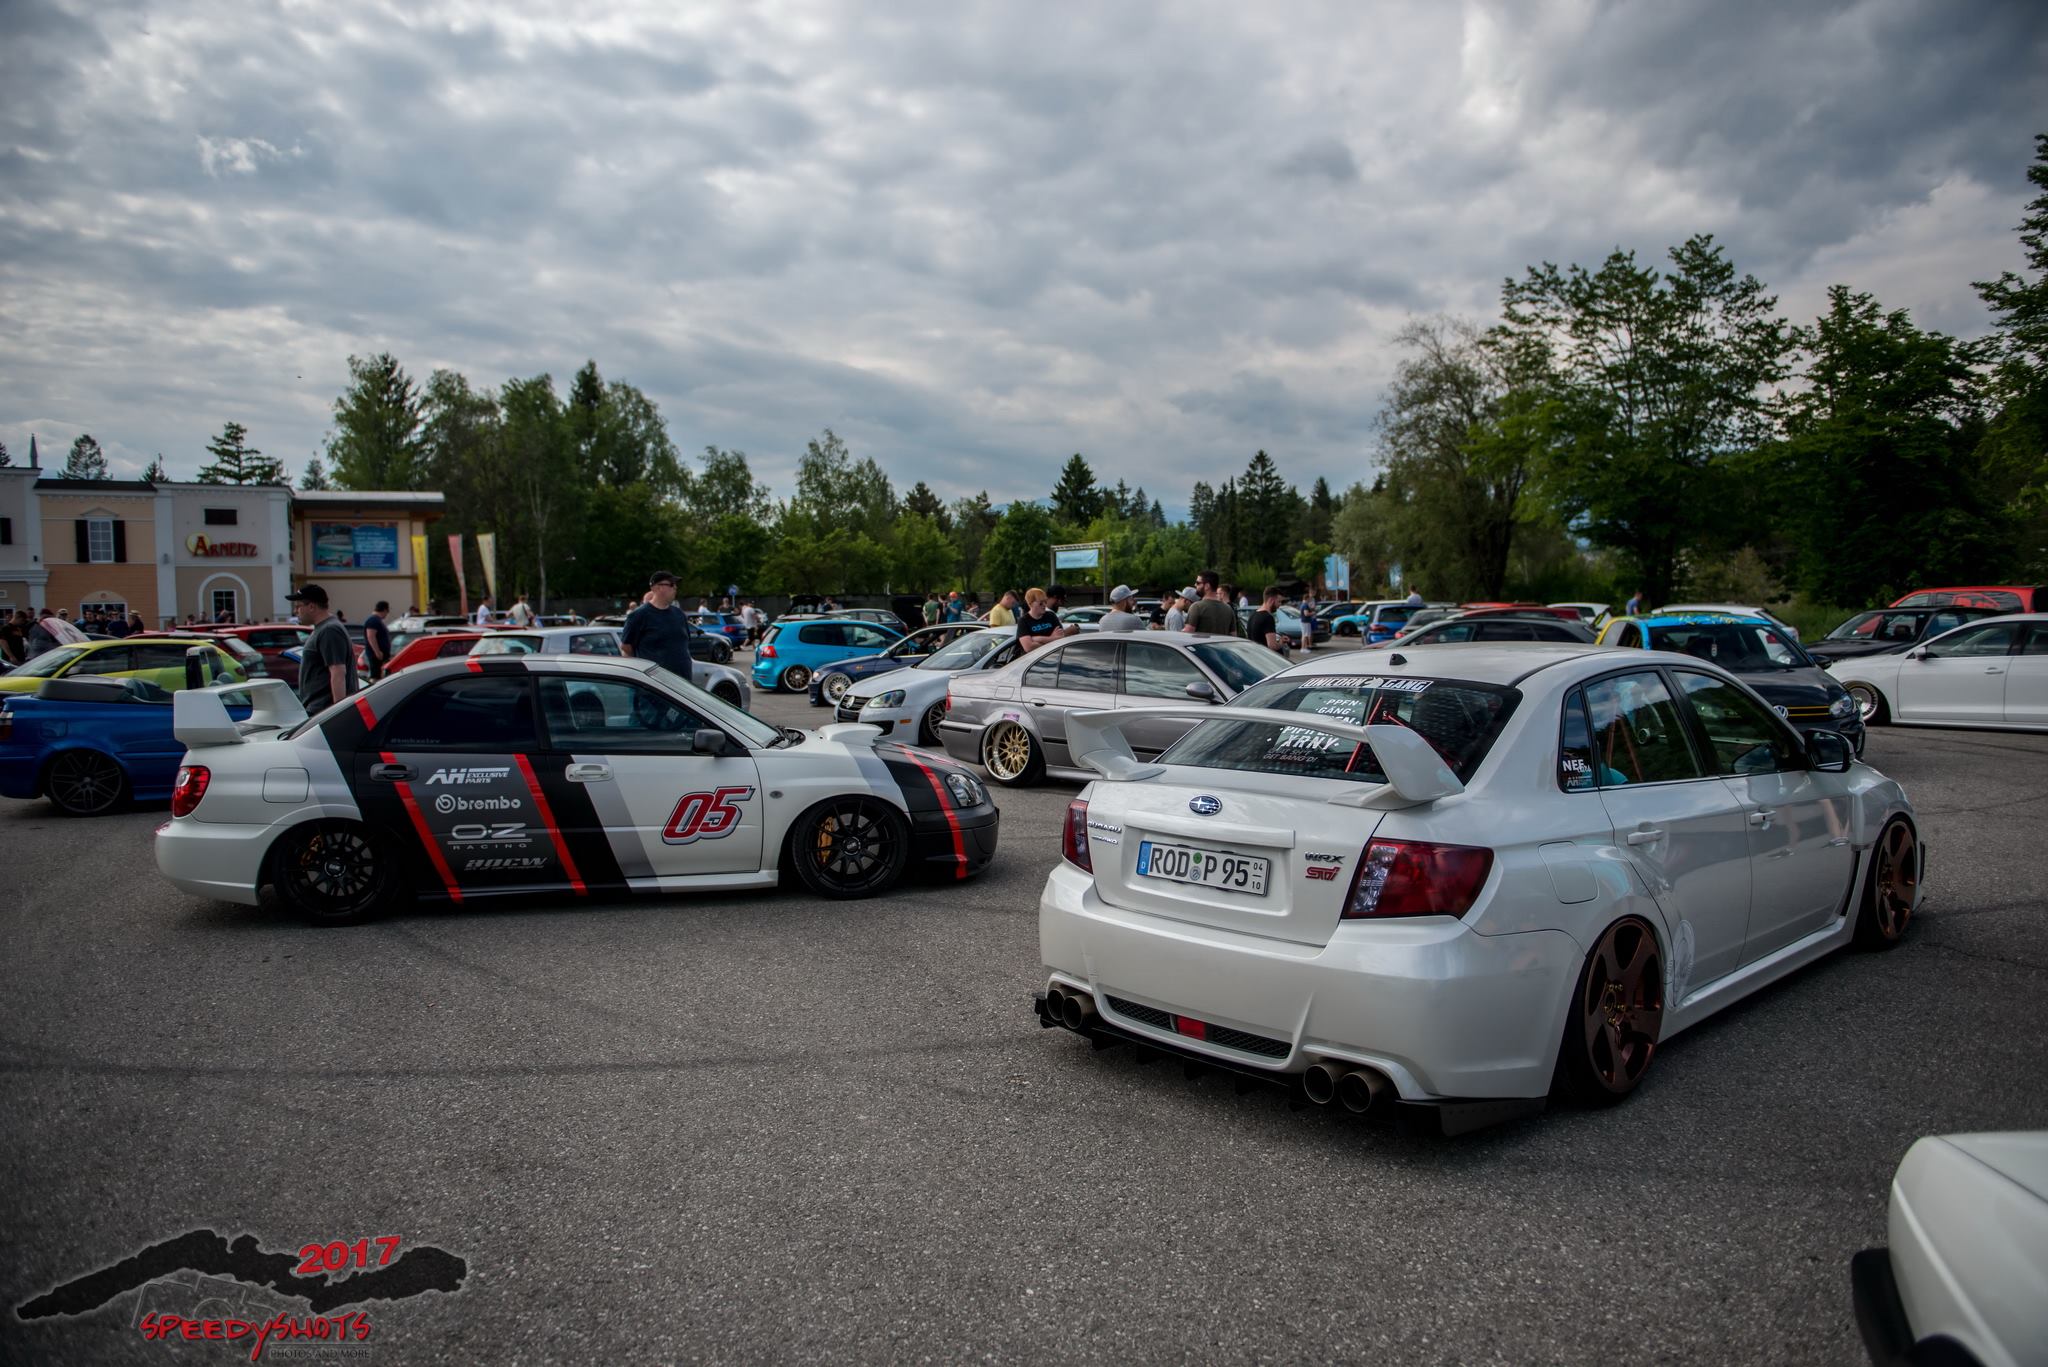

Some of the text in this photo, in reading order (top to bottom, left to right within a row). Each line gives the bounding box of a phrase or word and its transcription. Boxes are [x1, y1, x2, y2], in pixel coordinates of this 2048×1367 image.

[1304, 677, 1428, 692] UNICORN GANG
[425, 768, 467, 785] AH
[457, 795, 522, 811] brembo
[661, 785, 756, 845] 05
[452, 843, 528, 851] RACING
[1304, 851, 1346, 865] WRX
[1140, 861, 1146, 870] D
[1149, 847, 1250, 887] ROD P 95
[1253, 862, 1263, 872] 04
[1251, 880, 1261, 890] 10
